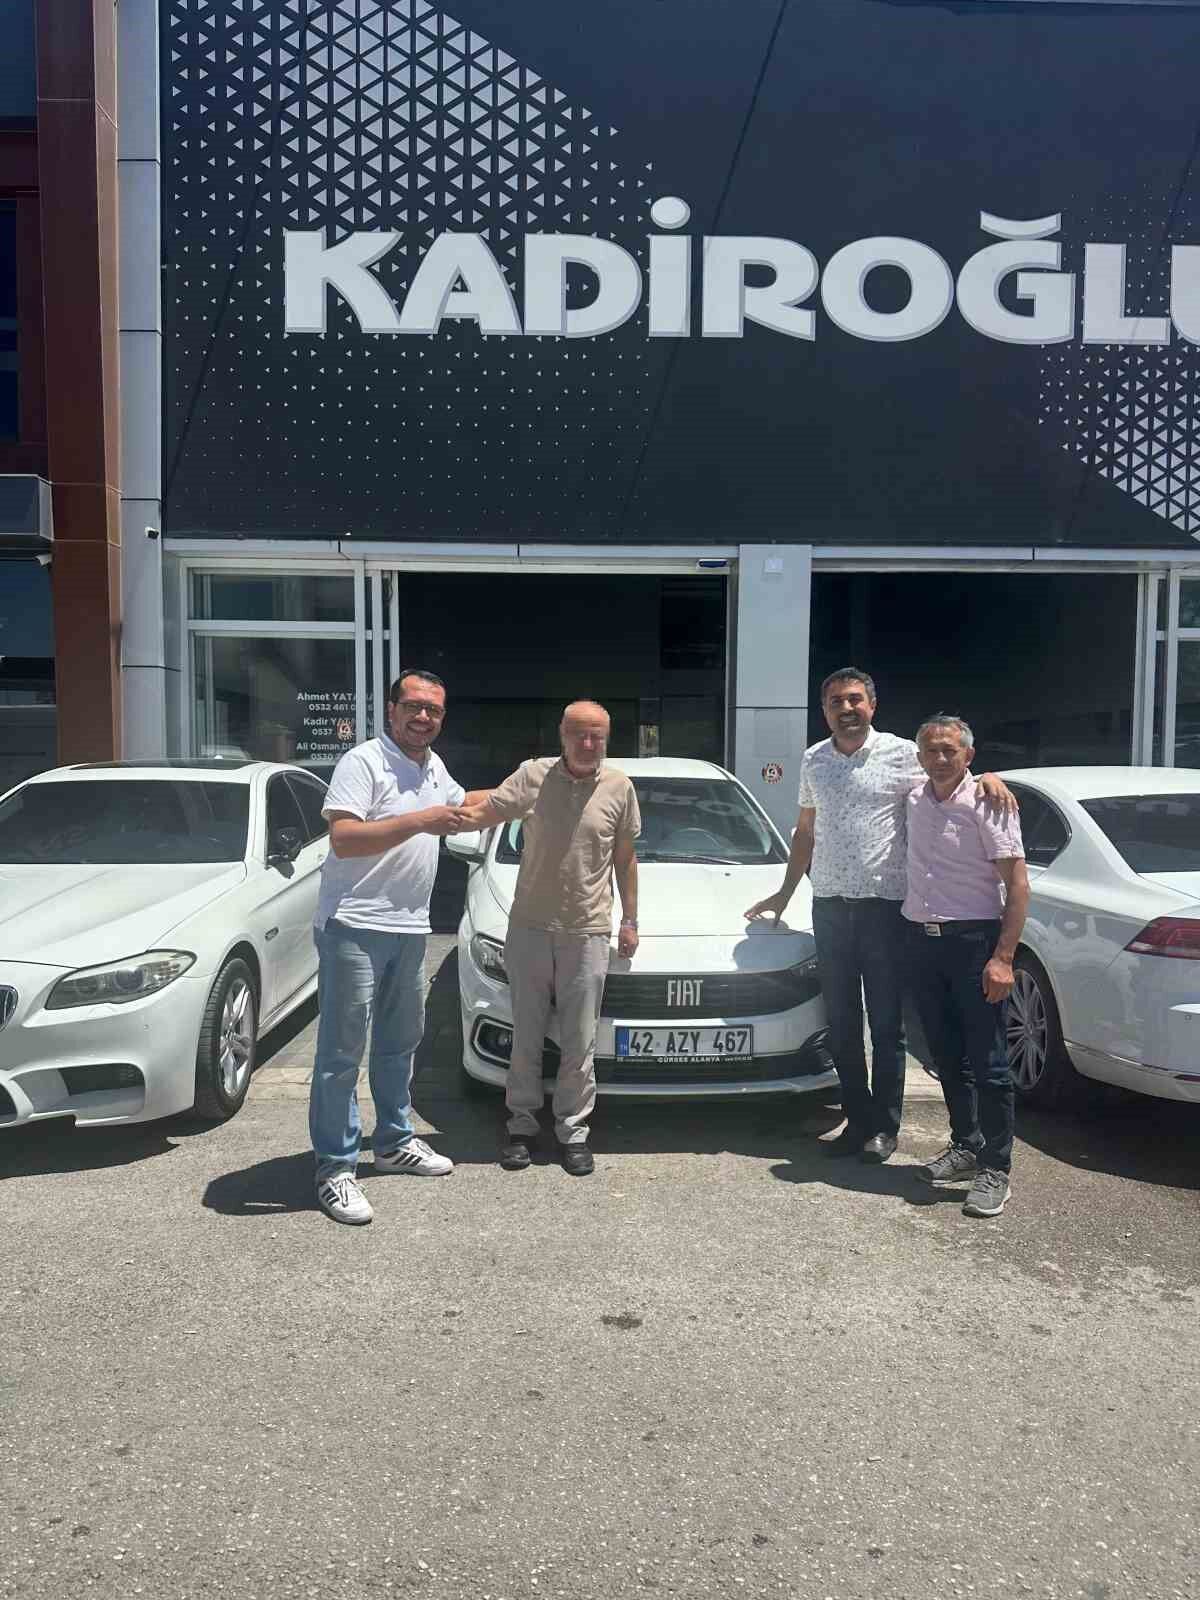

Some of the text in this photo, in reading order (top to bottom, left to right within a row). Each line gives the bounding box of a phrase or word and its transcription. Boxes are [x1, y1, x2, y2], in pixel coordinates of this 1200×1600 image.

[297, 692, 330, 701] Ahmet
[308, 703, 331, 711] 0532
[303, 717, 328, 726] Kadir
[310, 742, 340, 750] Osman
[666, 979, 704, 1006] FIAT
[630, 1031, 748, 1053] 42 AZY 467
